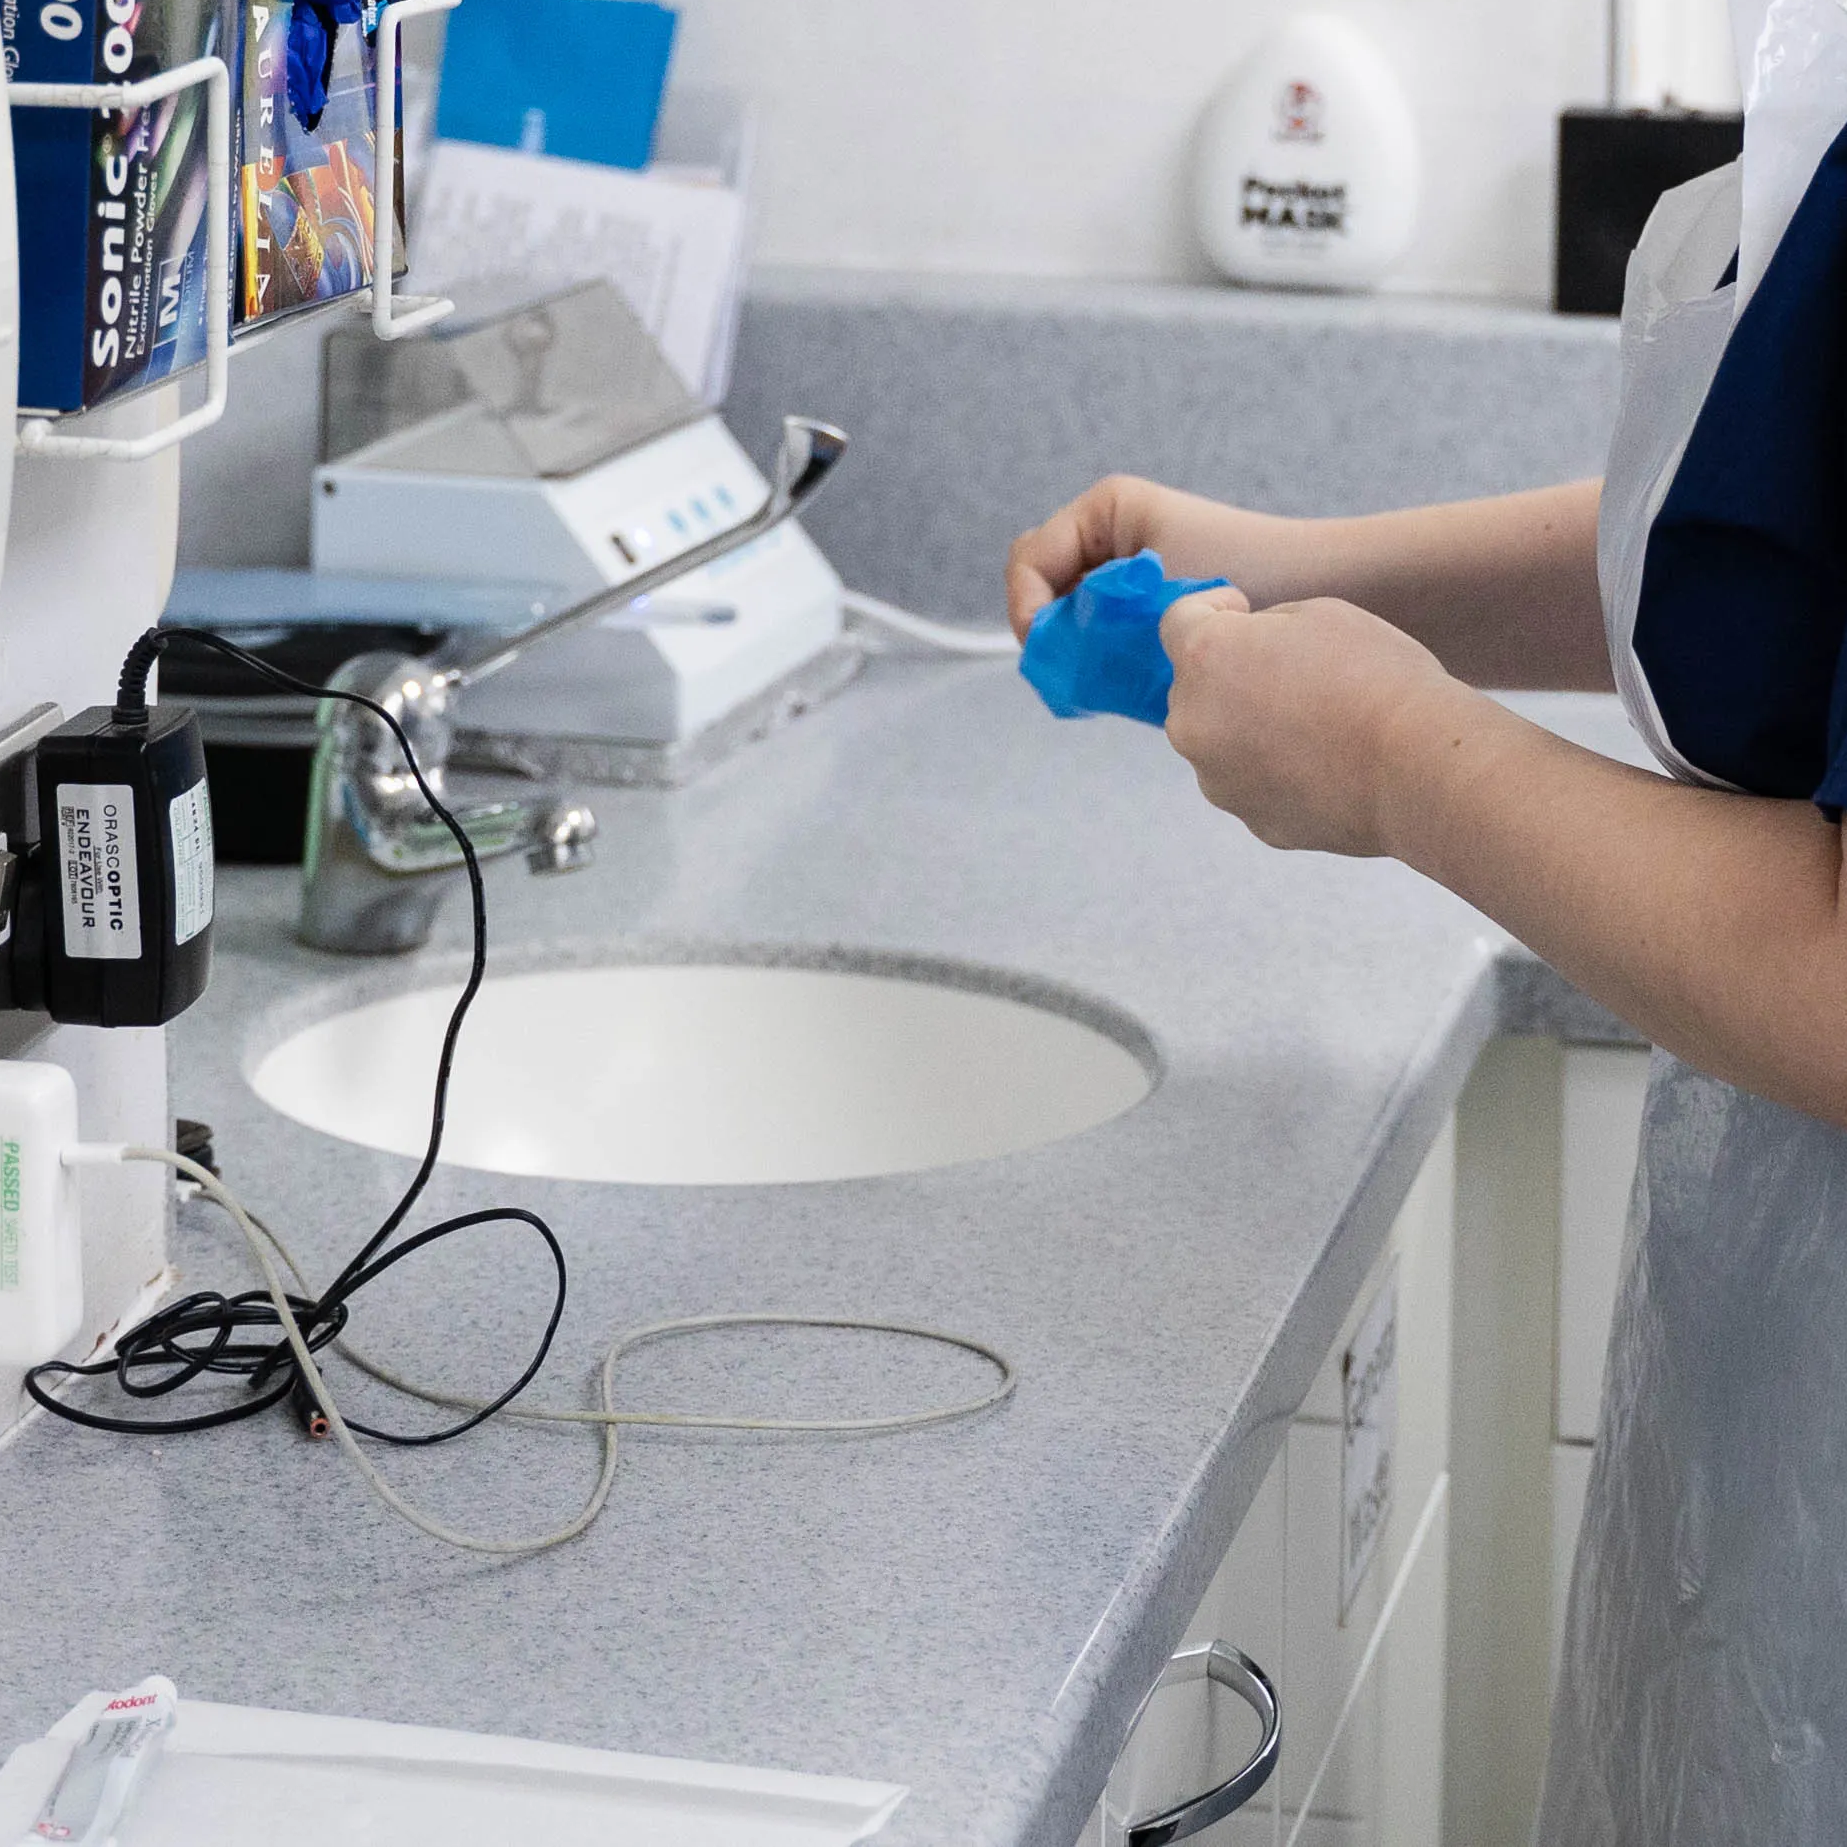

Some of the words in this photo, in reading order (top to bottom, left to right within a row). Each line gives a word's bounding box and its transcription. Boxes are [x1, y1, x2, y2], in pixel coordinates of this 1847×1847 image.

[4, 46, 20, 83] Glo
[253, 5, 274, 307] AURELIA
[130, 162, 149, 263] Powder
[136, 239, 153, 355] Examination
[146, 172, 158, 231] Gloves
[159, 273, 181, 327] M
[124, 273, 142, 359] Nitrile
[68, 860, 78, 880] LOT
[76, 809, 95, 928] ENDEAVOUR
[103, 804, 123, 931] ORASCOPTIC
[3, 1142, 20, 1212] PASSED
[4, 1257, 18, 1285] TEST
